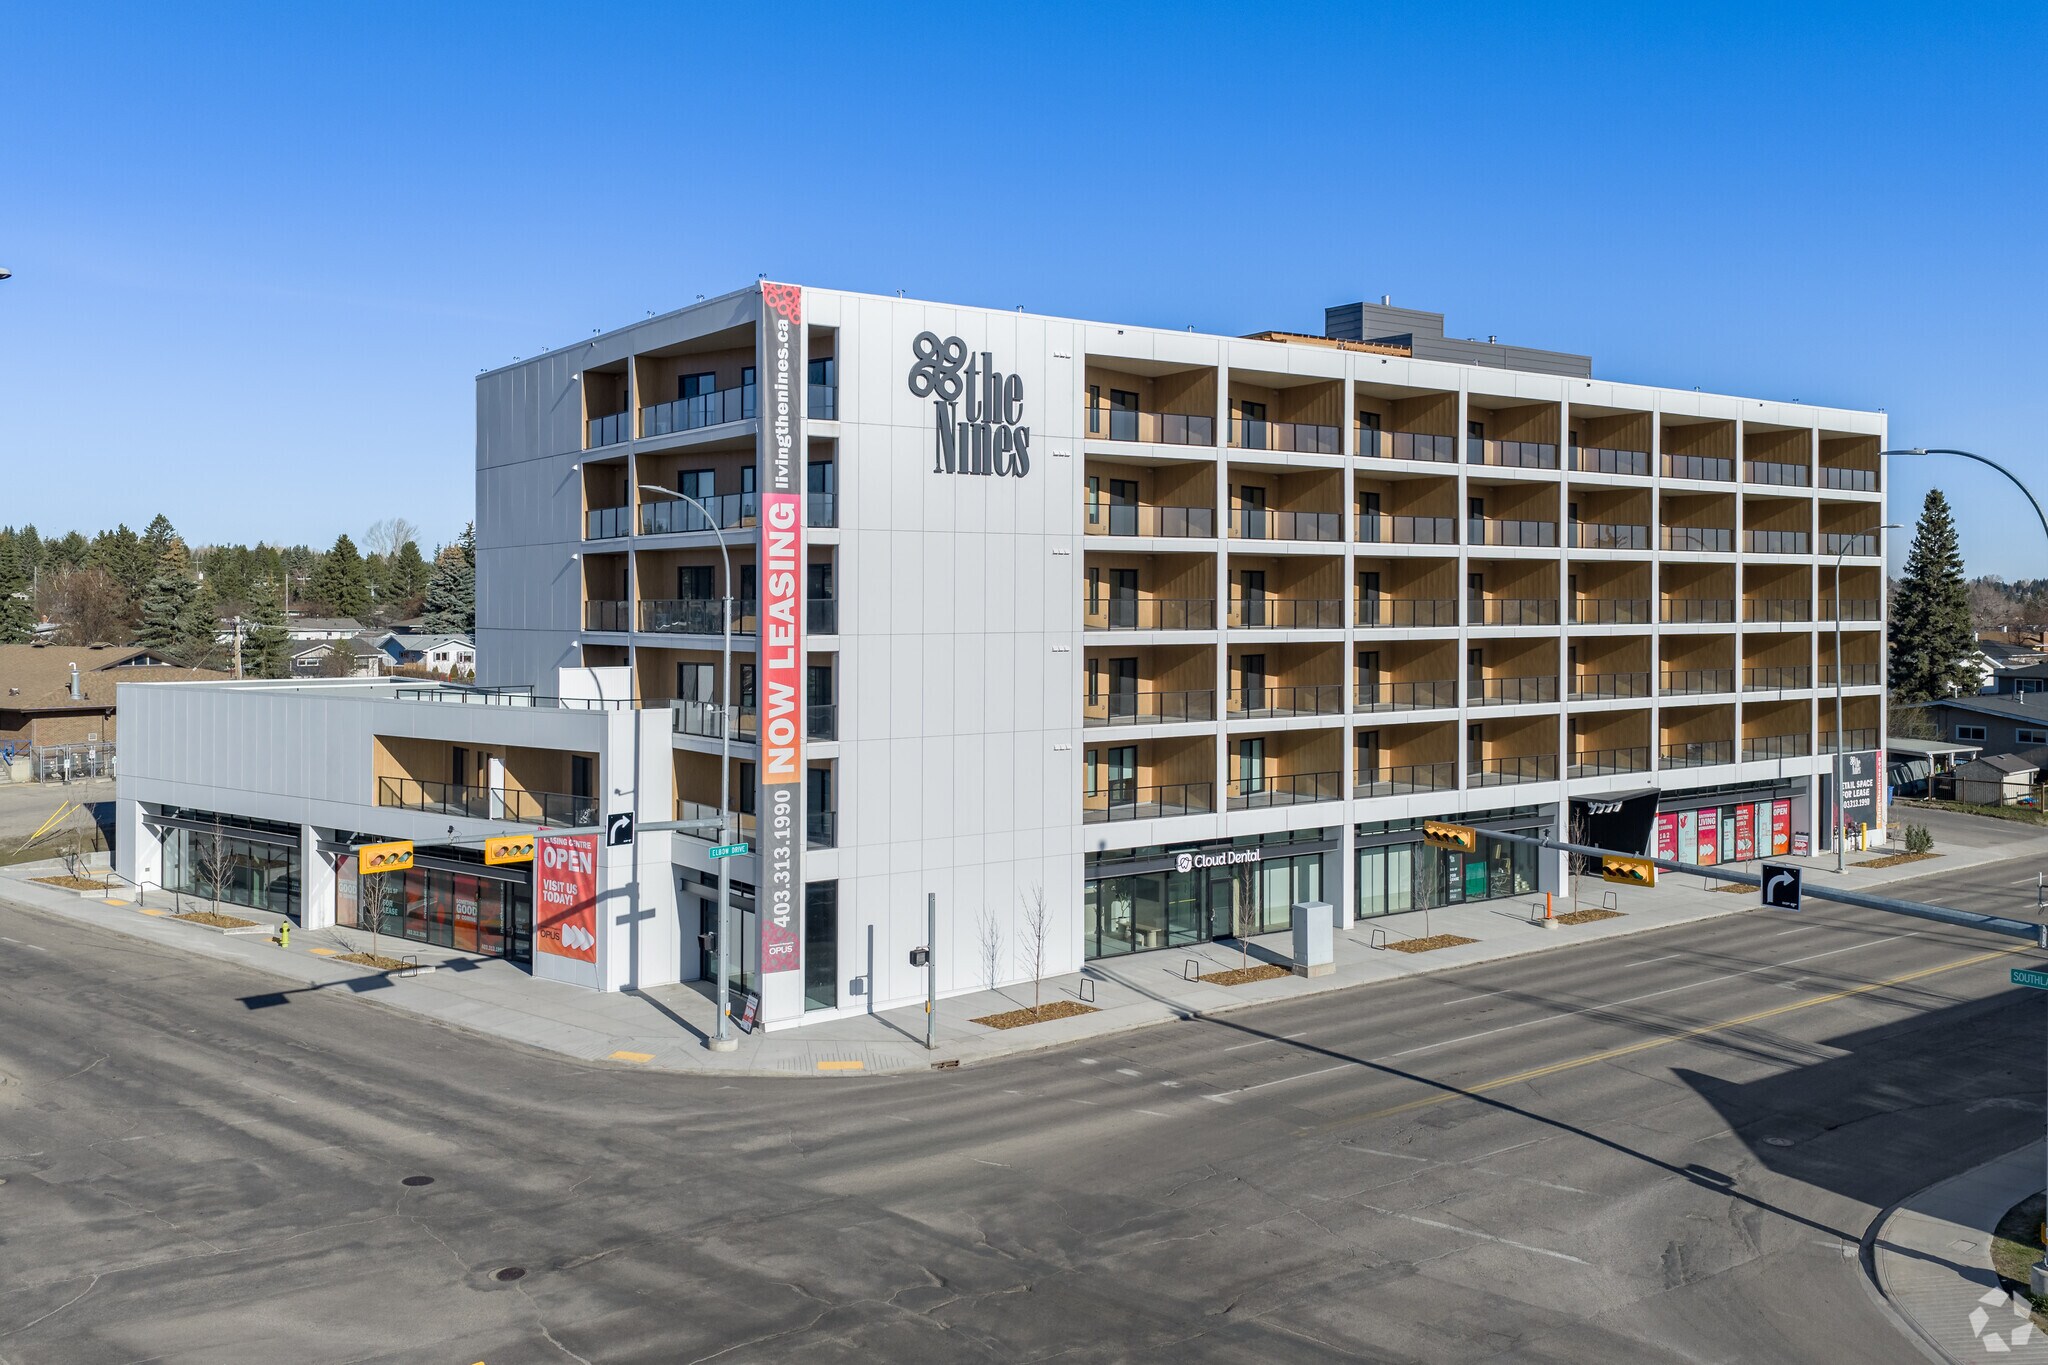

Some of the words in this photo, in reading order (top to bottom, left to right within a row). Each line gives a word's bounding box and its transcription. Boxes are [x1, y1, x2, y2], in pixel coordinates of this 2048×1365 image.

[964, 351, 1024, 426] the
[774, 319, 792, 489] livingthenines.ca
[933, 400, 1030, 478] Nines
[768, 502, 796, 669] LEASING
[768, 681, 795, 774] NOW
[1843, 781, 1855, 789] ETAIL
[1857, 779, 1873, 788] SPACE
[1853, 788, 1870, 797] LEASE
[568, 839, 592, 850] CENTRE
[712, 848, 729, 857] ELBOW
[731, 845, 745, 854] DRIVE
[543, 846, 592, 875] OPEN
[773, 789, 791, 928] 403.313.1990
[1194, 852, 1226, 868] Cloud
[1228, 848, 1261, 865] Dental
[543, 879, 565, 892] VISIT
[566, 883, 578, 895] US
[542, 890, 573, 905] TODAY!
[456, 904, 477, 916] GOOD
[540, 929, 560, 941] OPUS
[769, 945, 793, 955] OPUS
